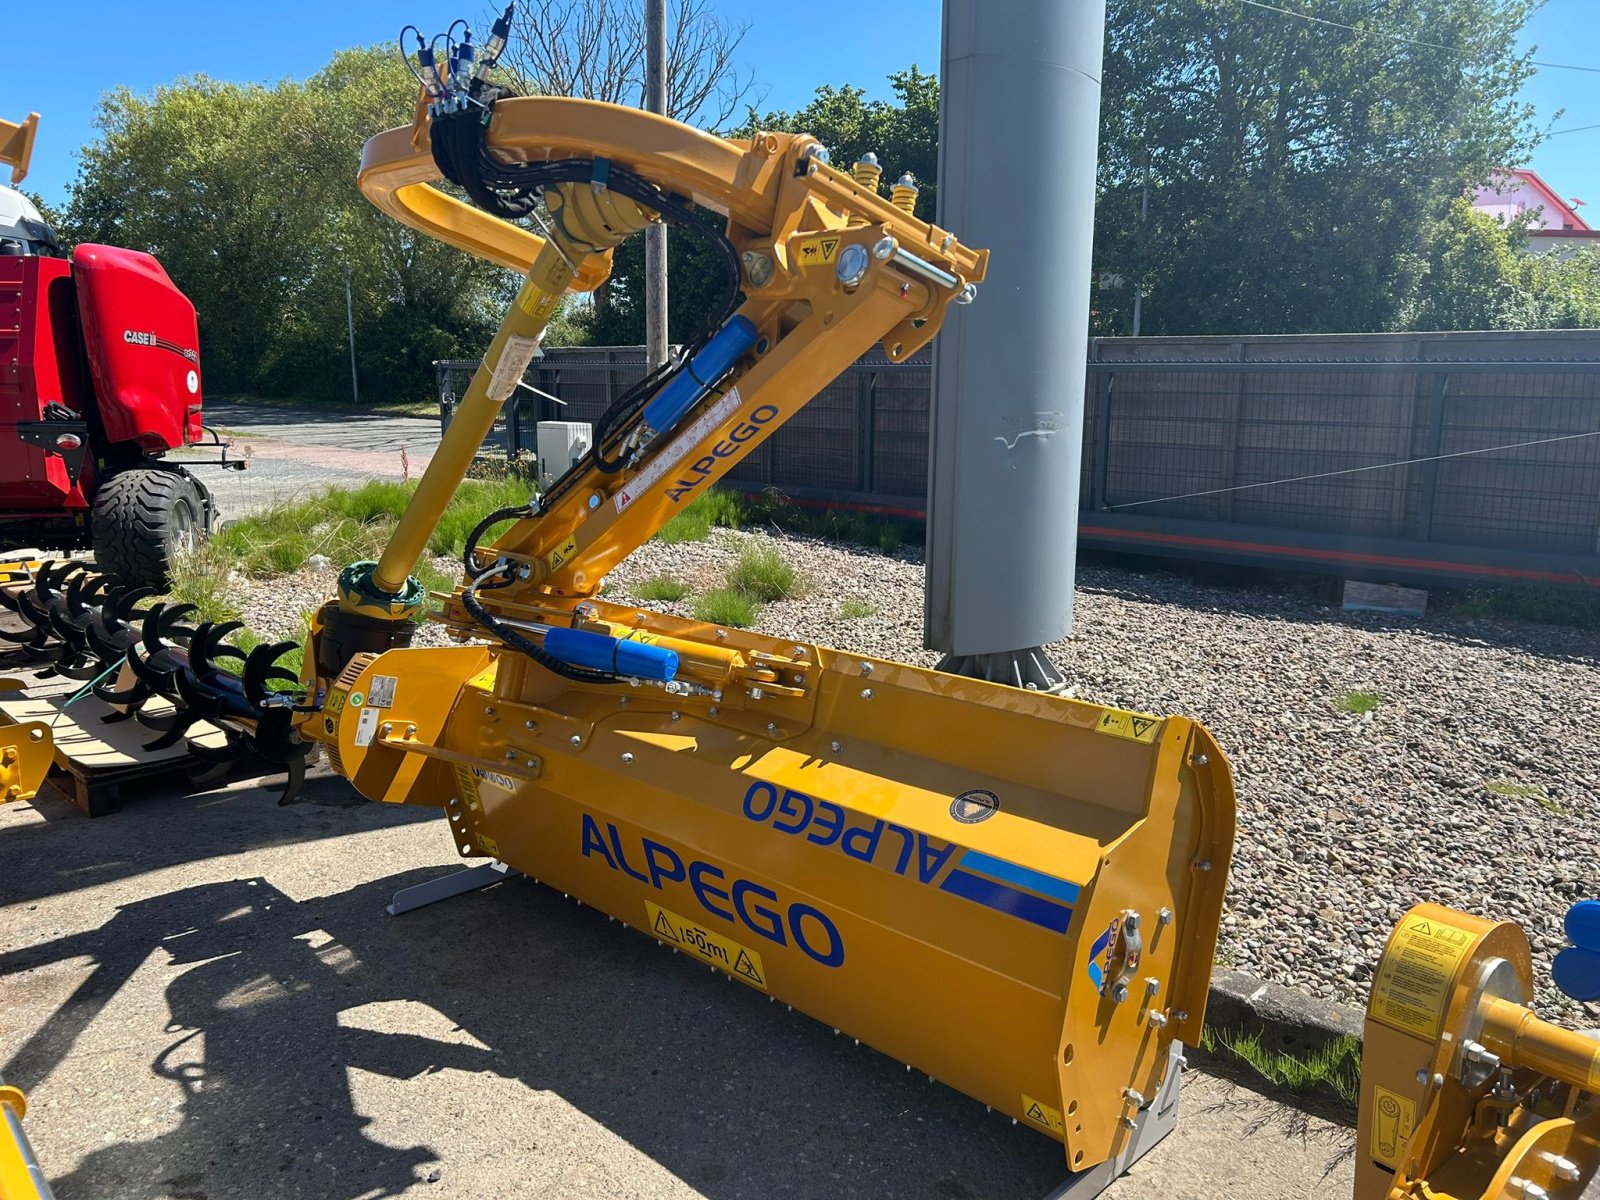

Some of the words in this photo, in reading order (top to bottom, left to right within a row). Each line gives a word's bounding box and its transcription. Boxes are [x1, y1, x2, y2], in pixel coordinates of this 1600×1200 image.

[123, 329, 149, 345] CASE
[664, 404, 779, 504] ALPEGO
[742, 780, 958, 885] ALPEGO
[581, 812, 846, 969] ALPEGO
